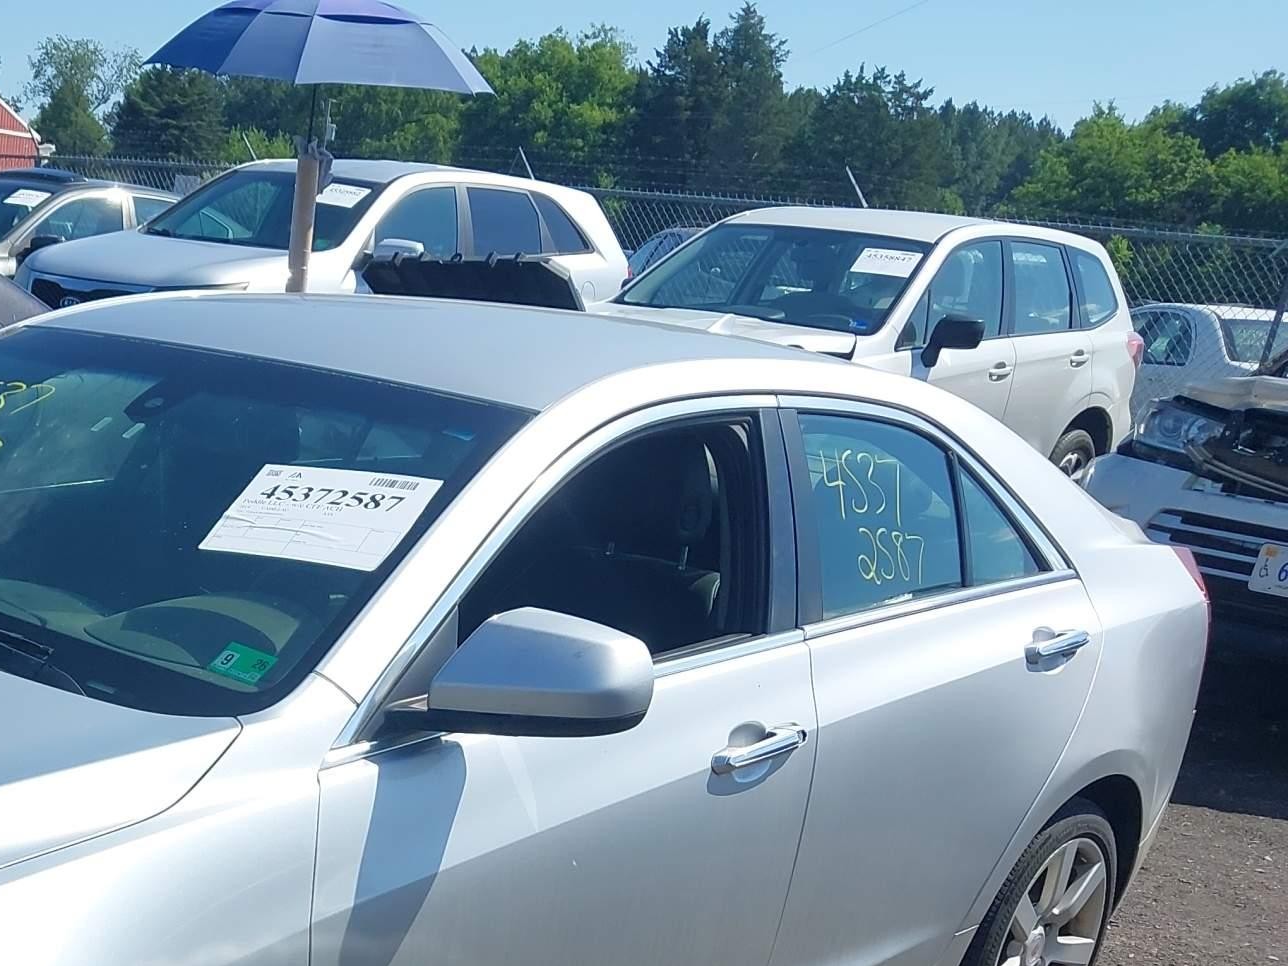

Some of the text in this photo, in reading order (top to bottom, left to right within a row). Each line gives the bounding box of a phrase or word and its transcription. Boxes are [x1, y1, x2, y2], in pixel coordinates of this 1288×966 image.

[260, 484, 407, 513] 45372587
[819, 448, 902, 527] 4537
[857, 528, 925, 585] 2587
[220, 653, 234, 666] 9
